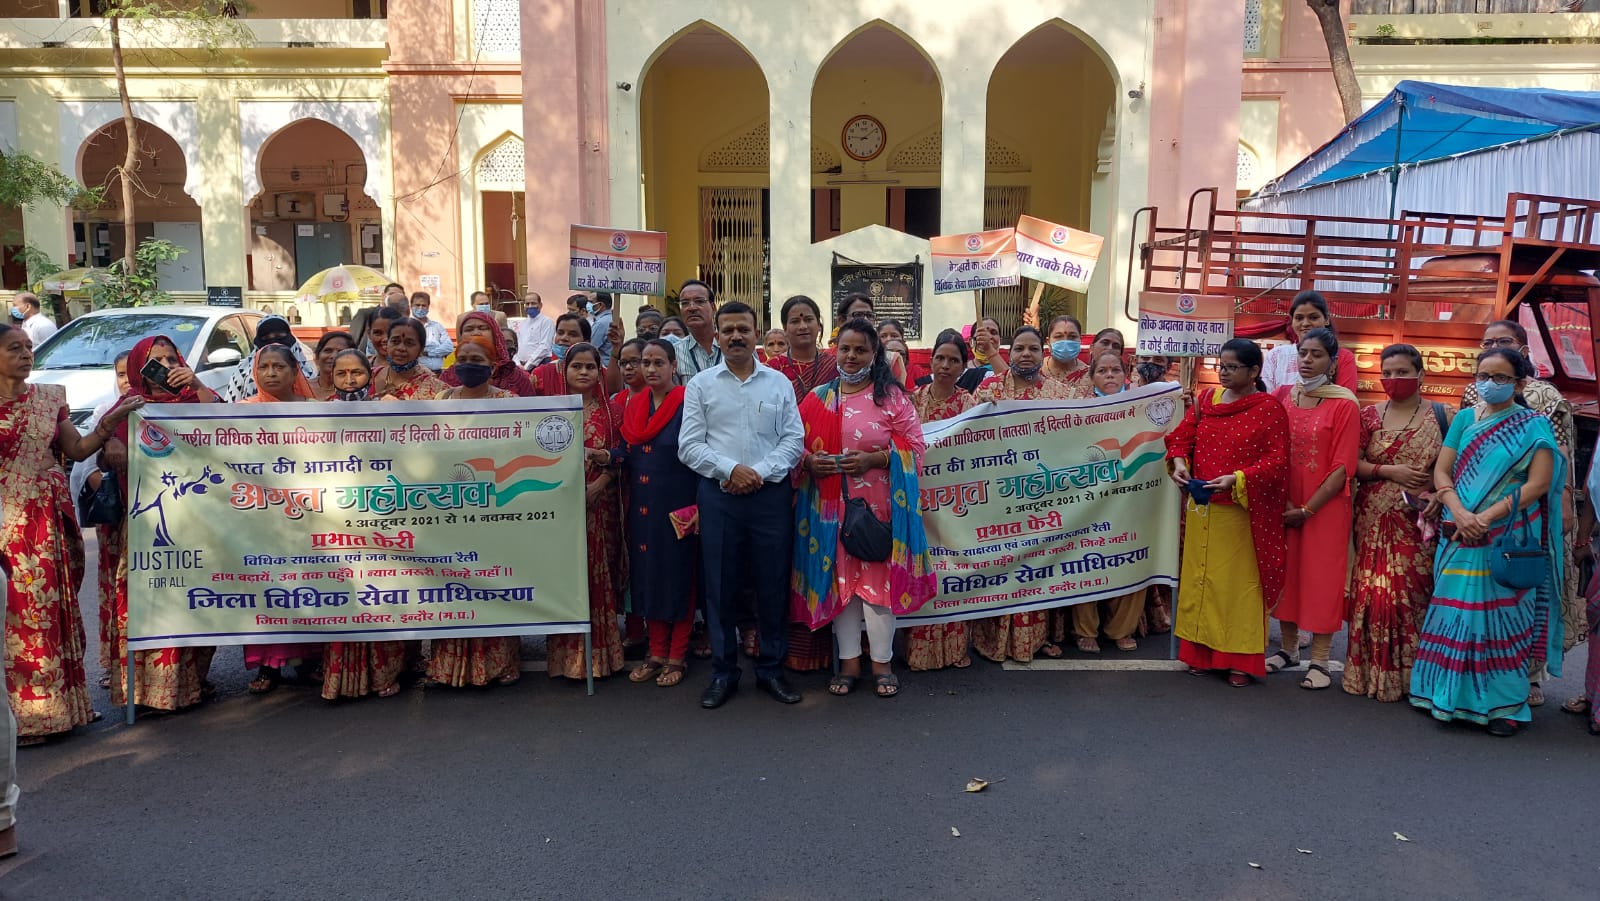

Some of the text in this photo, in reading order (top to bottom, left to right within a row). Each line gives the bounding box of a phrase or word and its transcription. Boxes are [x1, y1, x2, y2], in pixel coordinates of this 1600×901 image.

[625, 260, 634, 271] का
[635, 258, 643, 272] लो
[644, 262, 662, 273] सहारा
[971, 261, 980, 270] का
[1016, 250, 1035, 265] याय
[1035, 257, 1061, 272] सबके
[1062, 261, 1082, 278] लिये
[577, 278, 586, 288] घर
[597, 276, 609, 289] करो
[610, 277, 632, 292] आवेदन
[934, 280, 954, 292] विधिक
[954, 278, 967, 290] सेवा
[968, 276, 996, 289] प्राधिकरण
[1140, 315, 1157, 330] लोक
[1158, 320, 1184, 332] अदालत
[1185, 321, 1196, 332] का
[1197, 322, 1208, 334] यह
[1210, 322, 1224, 334] नारा
[1139, 336, 1221, 356] न कोई जीता न कोई हारा
[215, 428, 252, 446] विधिक
[256, 427, 279, 446] सेवा
[282, 426, 337, 445] प्राधिकरण
[341, 428, 386, 445] (नालसा)
[390, 424, 406, 444] नई
[410, 424, 440, 442] दिल्ली
[444, 424, 455, 441] के
[458, 424, 510, 441] तत्वावधान
[954, 428, 996, 446] प्राधिकरण
[998, 421, 1032, 442] (नालसा)
[1033, 416, 1046, 434] नई
[1047, 414, 1072, 432] दिल्ली
[1074, 414, 1082, 426] के
[272, 456, 296, 474] की
[304, 454, 362, 474] आजादी
[368, 459, 392, 472] का
[947, 456, 965, 473] की
[971, 448, 1018, 470] आजादी
[1022, 449, 1040, 462] का
[997, 459, 1121, 502] महोत्सव
[230, 474, 493, 519] अमृत महोत्सव
[1006, 478, 1162, 515] 2 अक्टूबर 2021 से 14 नवम्बर 2021
[345, 511, 556, 530] 2 अक्टूबर 2021 से 14 नवम्बर 2021
[976, 510, 1062, 540] प्रभात फेरी
[311, 530, 415, 550] प्रभात फेरी
[962, 544, 1002, 556] साक्षरता
[1004, 538, 1018, 551] एवं
[1090, 522, 1112, 534] रैली
[130, 550, 204, 572] JUSTICE
[244, 554, 288, 566] विधिक
[290, 556, 340, 564] साक्षरता
[344, 552, 362, 564] एवं
[366, 554, 387, 562] जन
[455, 551, 478, 563] रैली
[972, 560, 990, 570] तक
[211, 572, 234, 582] हाथ
[278, 572, 298, 582] उन
[301, 571, 324, 580] तक
[368, 568, 396, 577] न्याय
[942, 546, 1150, 595] विधिक सेवा प्राधिकरण
[148, 576, 186, 589] FOR ALL
[187, 582, 534, 610] जिला विधिक सेवा प्राधिकरण
[933, 600, 960, 610] जिला
[963, 594, 1008, 605] न्यायालय
[1048, 580, 1076, 594] इन्दौर
[256, 614, 288, 626] जिला
[292, 616, 347, 626] न्यायालय
[352, 612, 395, 624] परिसर,
[400, 610, 434, 622] इन्दौर
